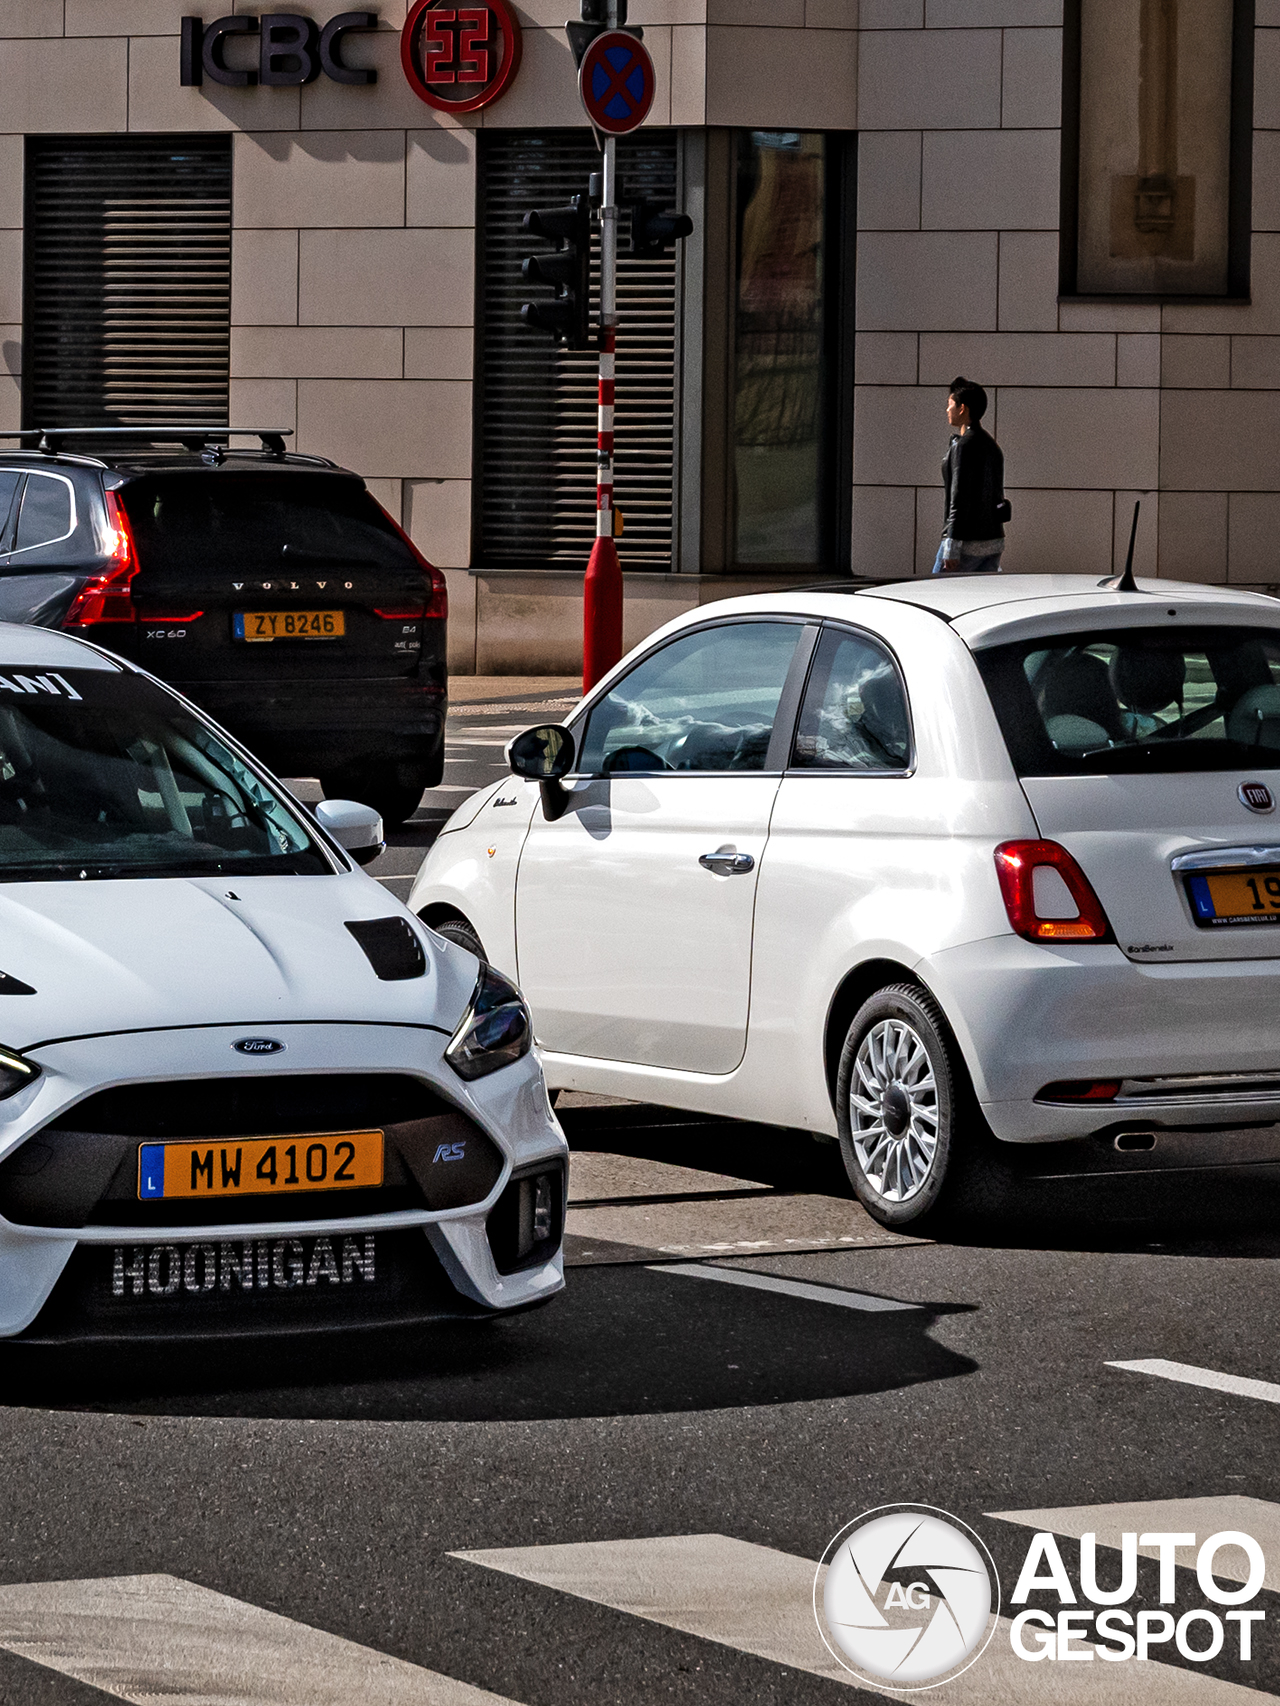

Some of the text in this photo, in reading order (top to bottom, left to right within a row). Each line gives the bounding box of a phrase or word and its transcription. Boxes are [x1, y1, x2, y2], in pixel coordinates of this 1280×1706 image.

[180, 11, 378, 87] ICBC
[232, 581, 353, 591] VOLVO
[255, 615, 278, 635] ZY
[284, 613, 335, 634] 8246
[1246, 789, 1269, 803] FIAT
[1200, 901, 1209, 912] L
[243, 1040, 274, 1051] Ford
[432, 1141, 466, 1163] RS
[147, 1141, 356, 1190] L MW 4102
[112, 1235, 376, 1296] HOONIGAN
